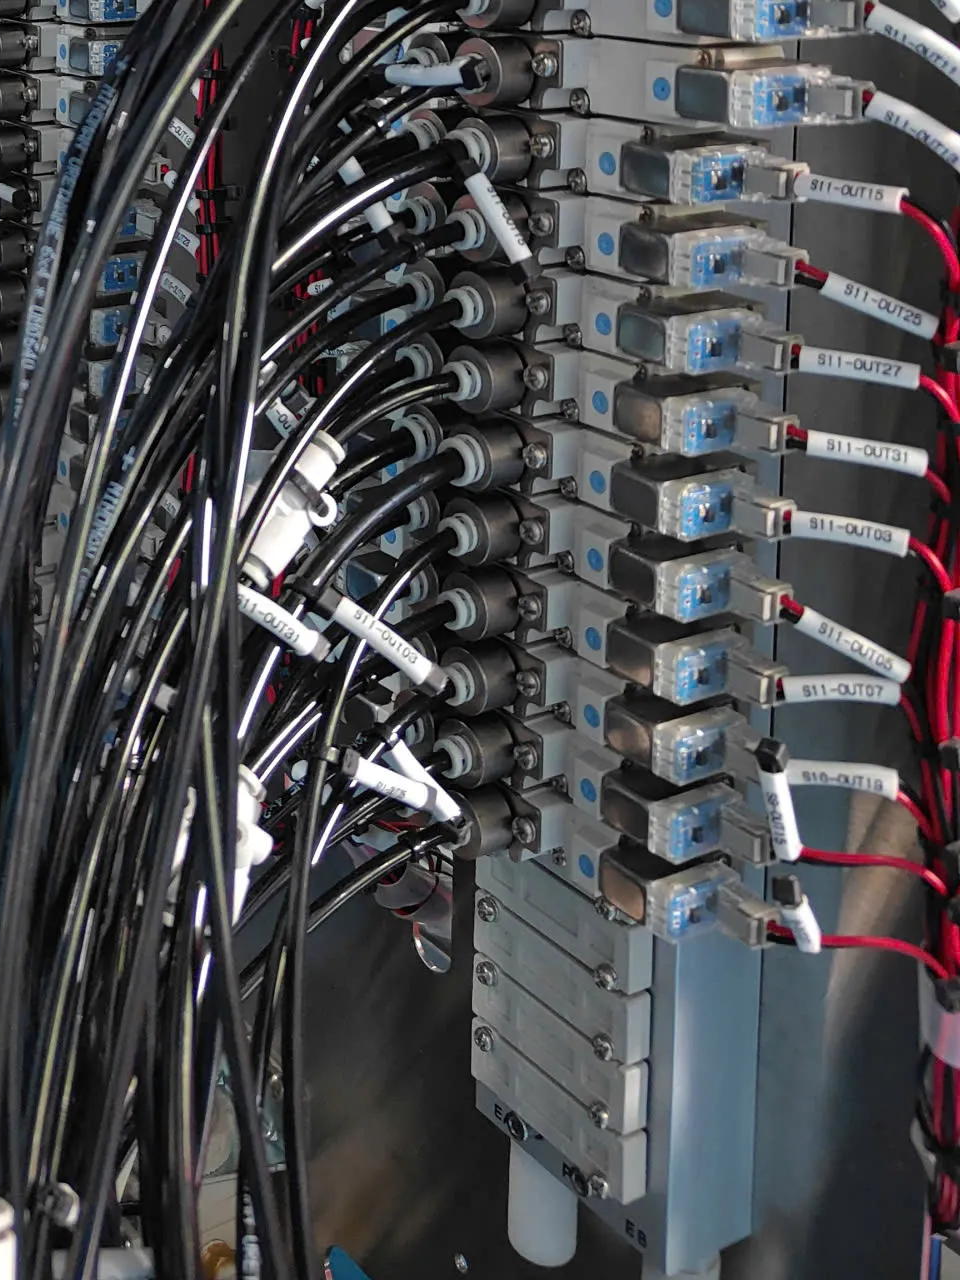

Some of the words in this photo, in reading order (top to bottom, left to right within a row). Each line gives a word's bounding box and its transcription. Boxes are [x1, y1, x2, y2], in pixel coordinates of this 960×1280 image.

[810, 178, 884, 202] S11-OUT15
[843, 283, 922, 327] S11-OUT25
[818, 353, 902, 377] S11-OUT27
[827, 439, 909, 463] S11-OUT31
[809, 517, 892, 543] S11-OUT03
[818, 622, 893, 670] S11-OUT05
[802, 684, 884, 698] S11-OUT07
